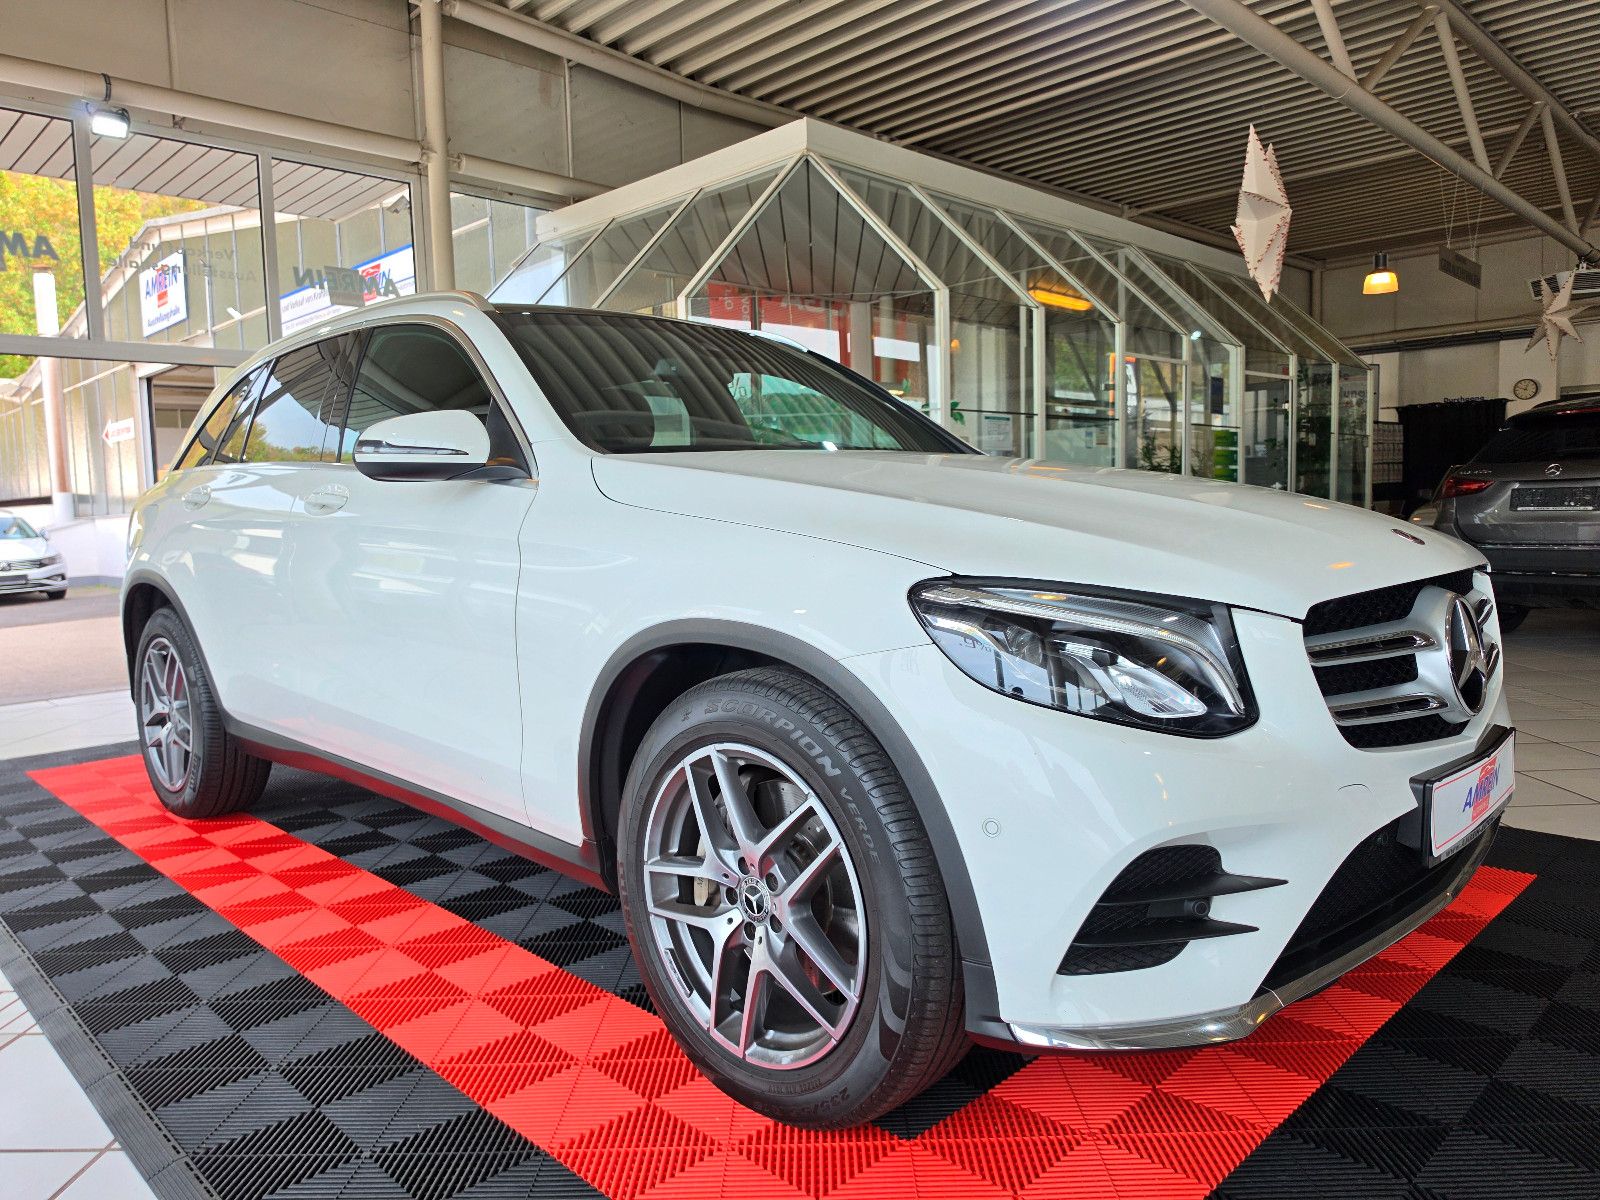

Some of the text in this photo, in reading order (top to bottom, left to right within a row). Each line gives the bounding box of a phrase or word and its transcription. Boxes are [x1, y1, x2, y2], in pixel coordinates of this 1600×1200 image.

[145, 264, 179, 300] AMREIN
[704, 699, 881, 865] SCORPION VERDE
[1462, 763, 1501, 813] AMREIN
